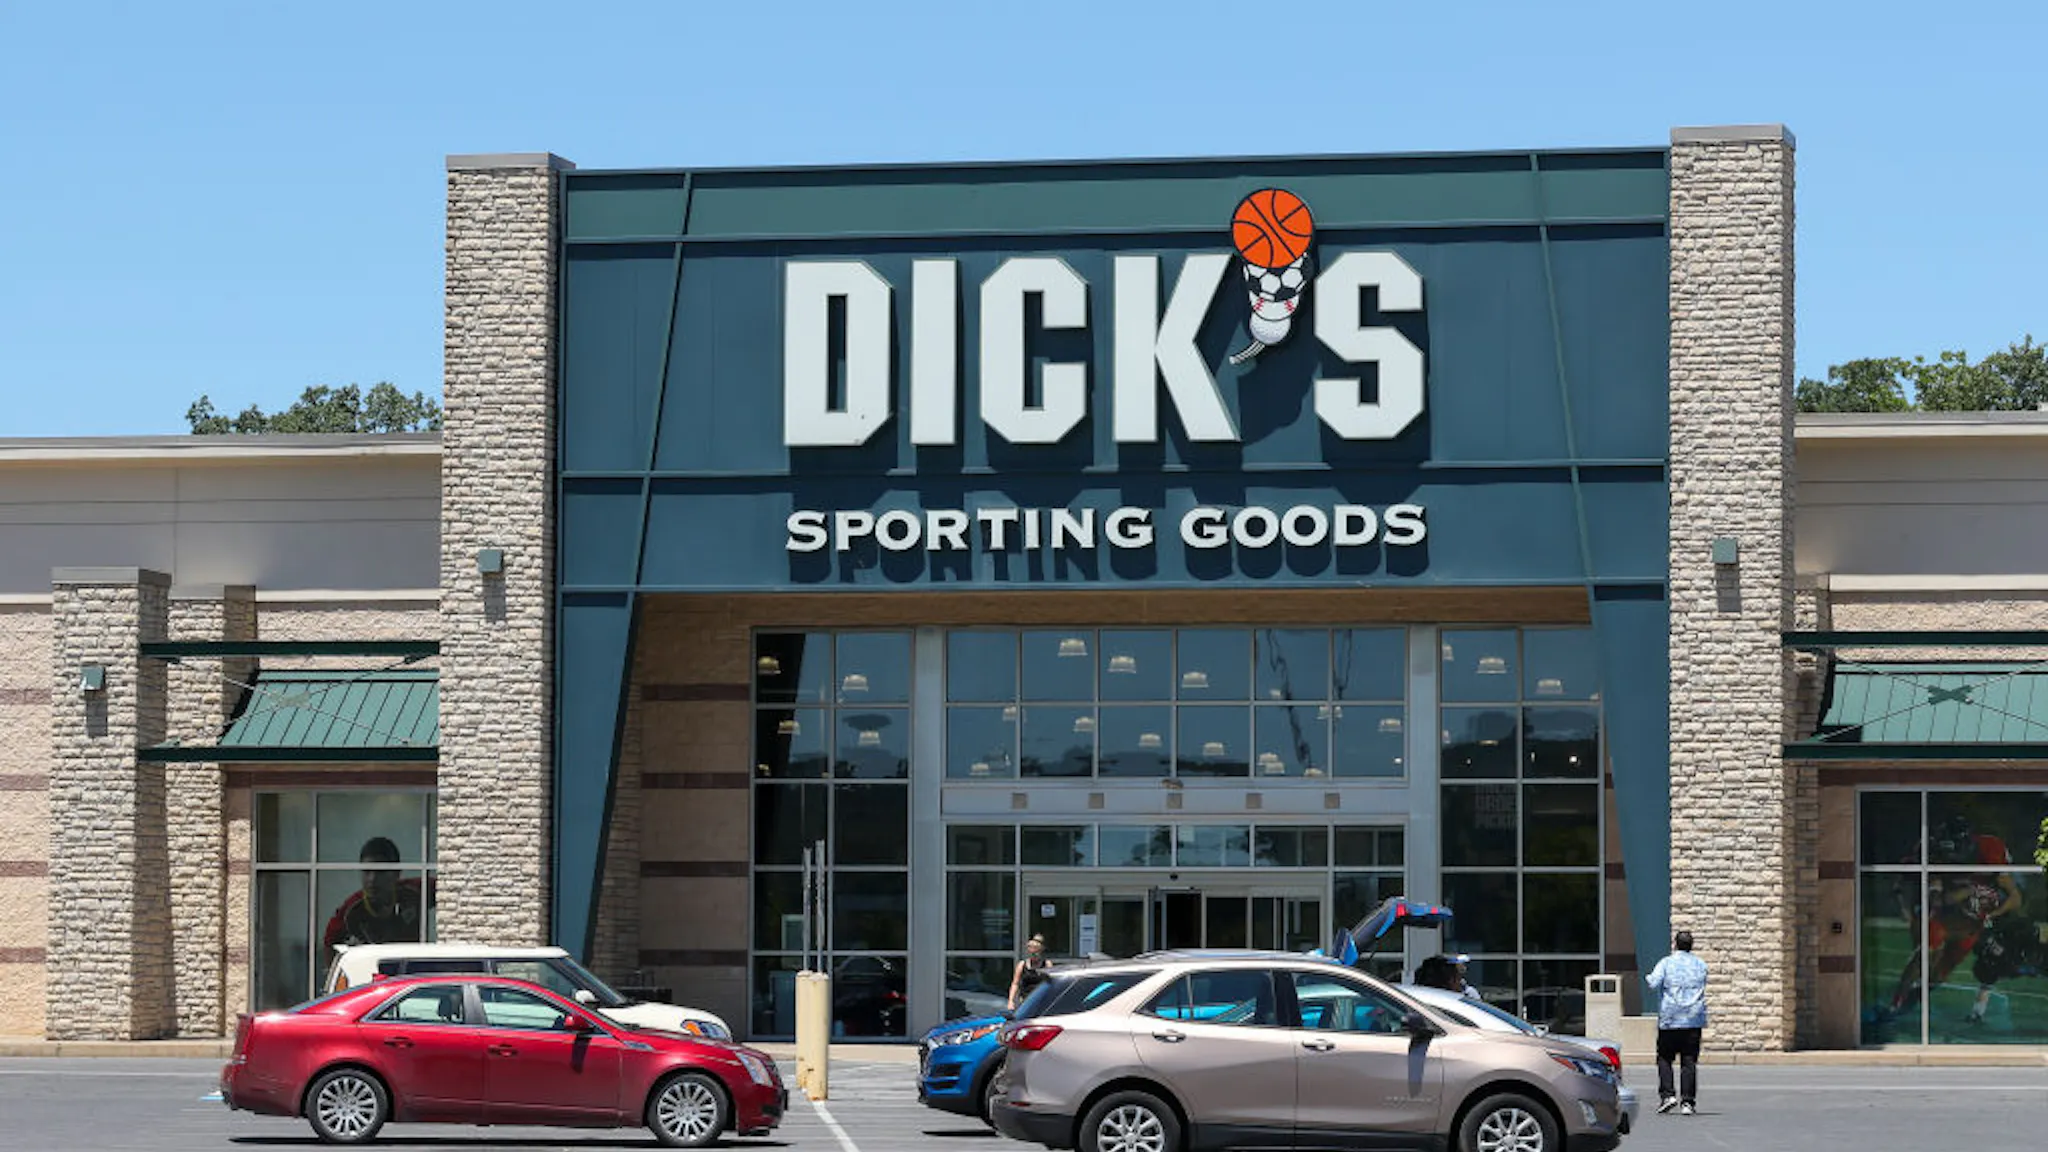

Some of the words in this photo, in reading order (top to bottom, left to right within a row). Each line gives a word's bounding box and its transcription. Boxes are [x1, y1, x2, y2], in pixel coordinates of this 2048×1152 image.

[784, 187, 1425, 446] DICK'S
[786, 507, 1153, 552] SPORTING
[1180, 504, 1427, 549] GOODS
